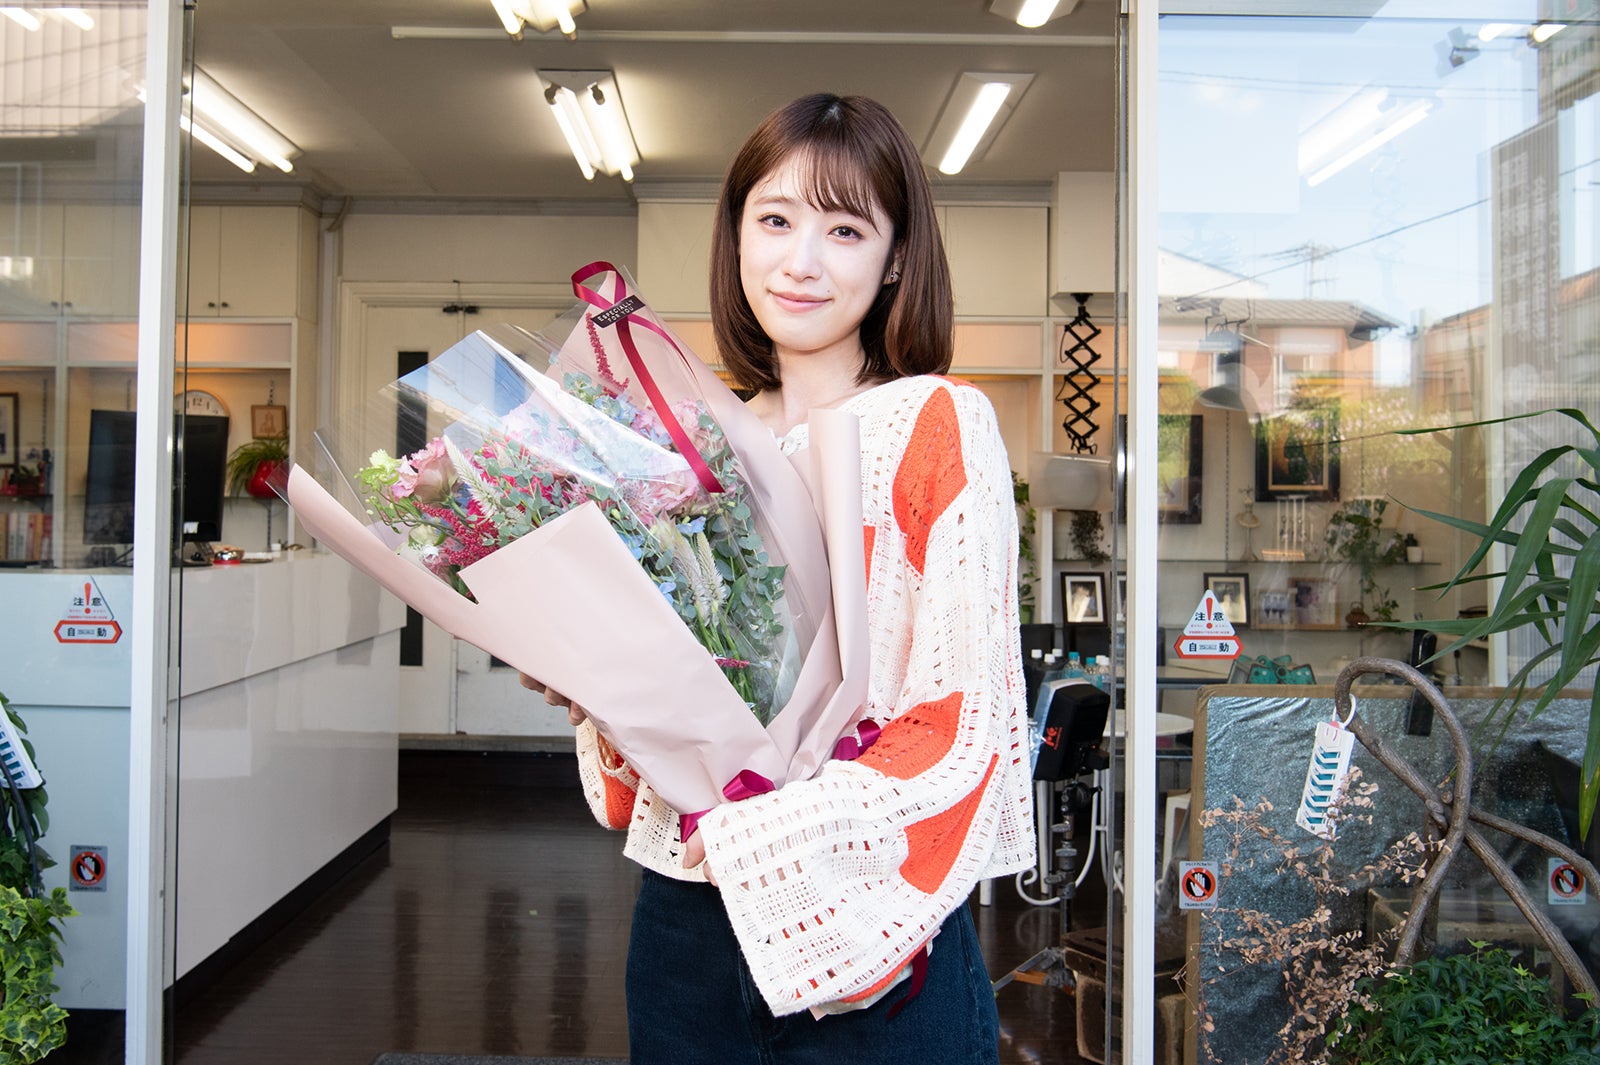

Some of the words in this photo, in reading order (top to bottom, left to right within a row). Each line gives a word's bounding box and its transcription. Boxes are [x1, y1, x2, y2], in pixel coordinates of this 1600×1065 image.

[597, 300, 634, 322] ESPECIALLY
[607, 314, 620, 322] FOR
[621, 306, 634, 315] YOU
